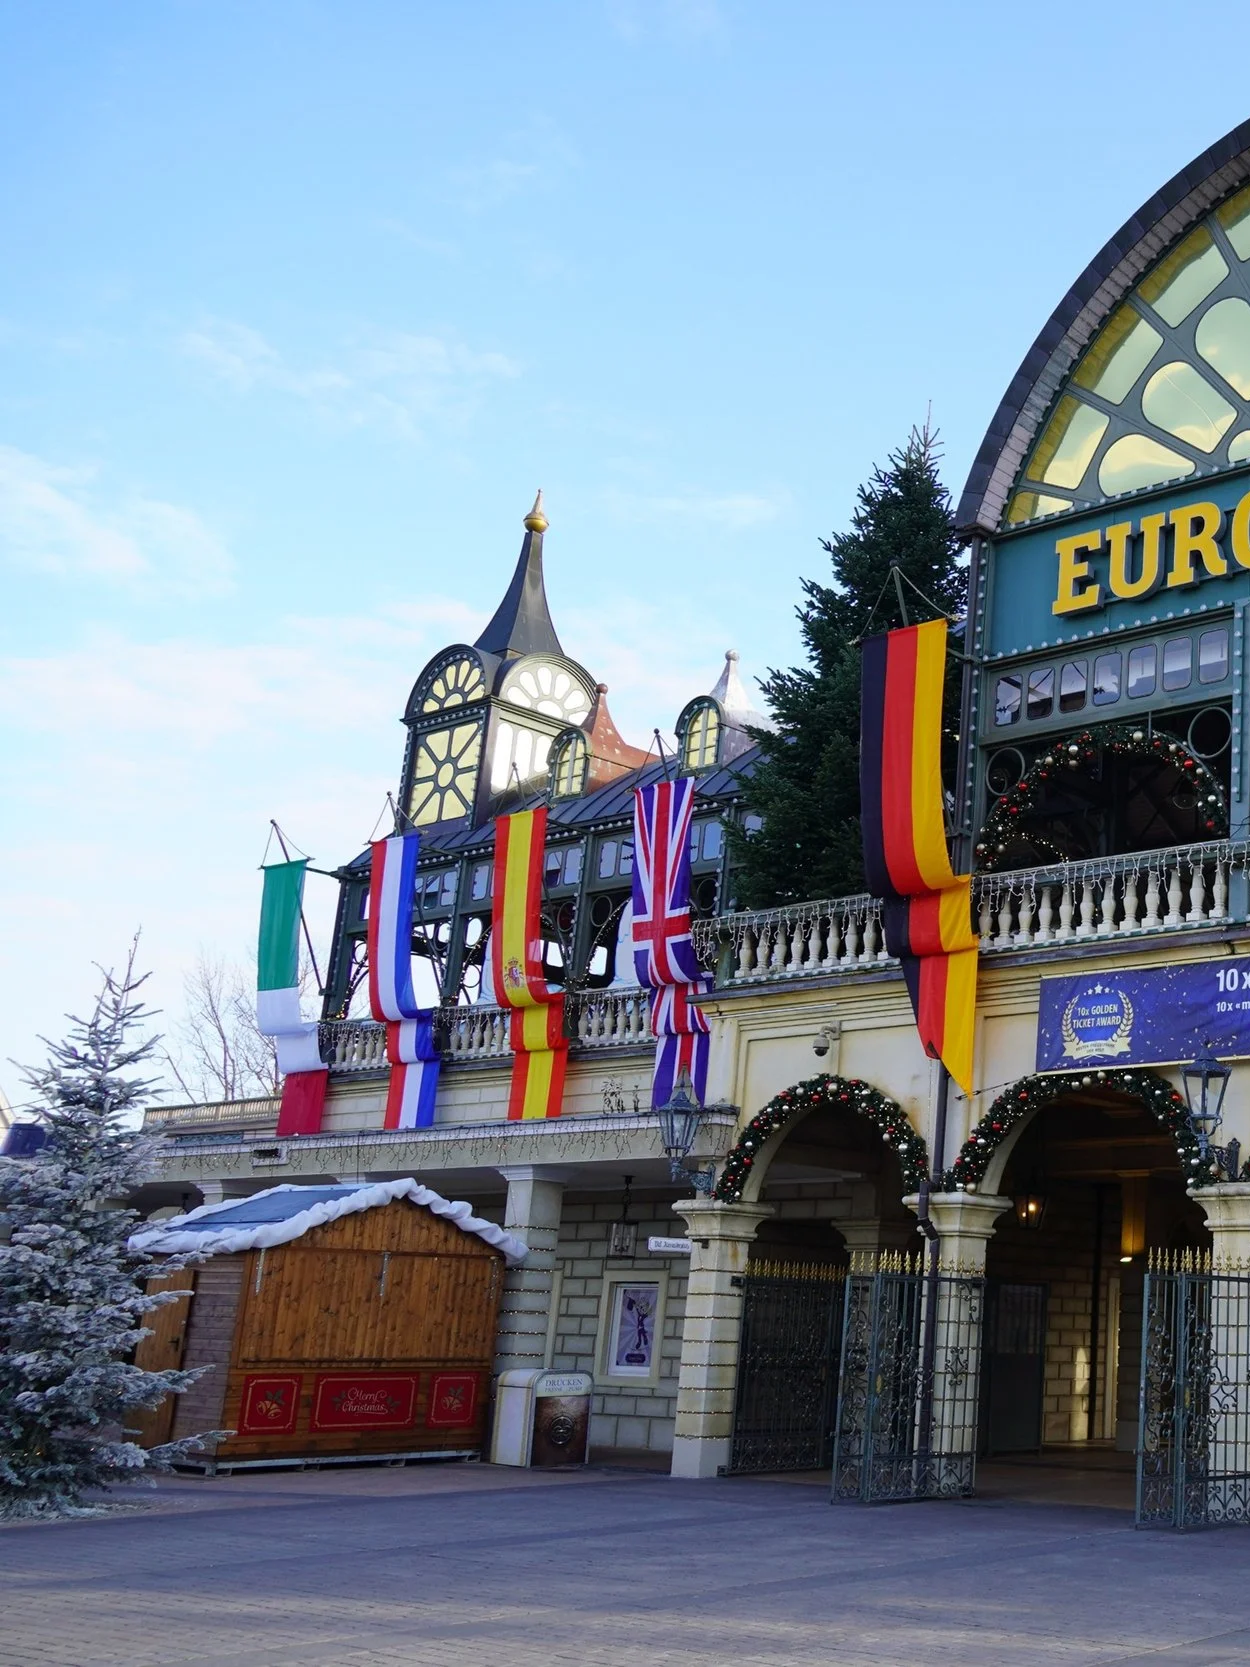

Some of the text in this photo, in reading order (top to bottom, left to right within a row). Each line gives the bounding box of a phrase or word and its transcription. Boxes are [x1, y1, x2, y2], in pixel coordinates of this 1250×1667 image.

[1216, 968, 1239, 992] 10
[1077, 1004, 1119, 1016] 10x GOLDEN
[1216, 1001, 1226, 1013] 10
[1227, 1002, 1233, 1012] x
[1072, 1015, 1122, 1029] TICKET AWARD
[347, 1387, 388, 1404] Merry
[342, 1401, 388, 1413] Christmas
